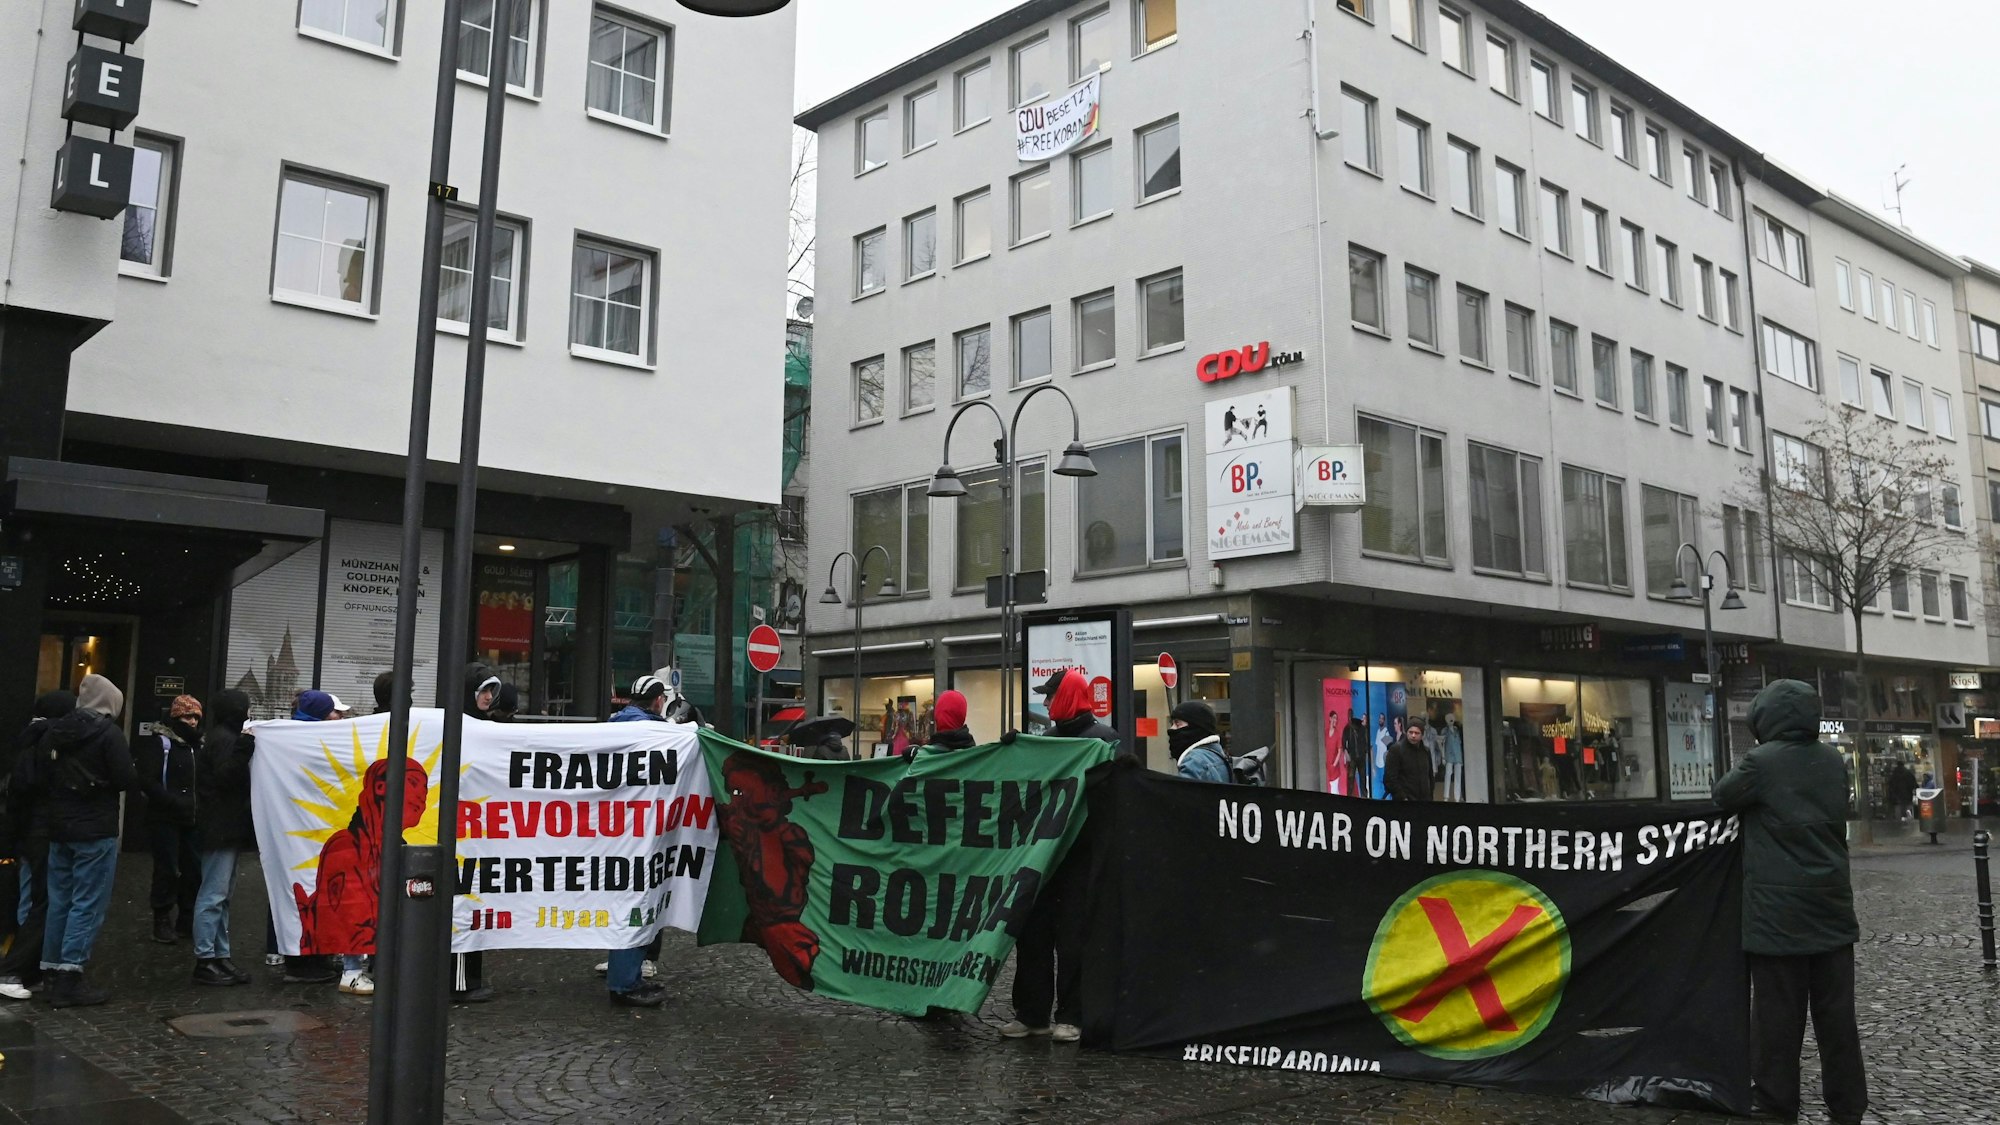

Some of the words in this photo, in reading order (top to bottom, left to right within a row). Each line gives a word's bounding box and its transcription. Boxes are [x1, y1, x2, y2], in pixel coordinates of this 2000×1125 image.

[1018, 106, 1045, 133] CDU
[1046, 81, 1093, 125] BESETZT
[436, 184, 452, 198] 17
[1196, 341, 1271, 383] CDU
[1272, 350, 1304, 368] KÖLN
[1211, 530, 1290, 549] NIGGEMANN
[346, 571, 424, 586] GOLDHANL
[422, 566, 430, 575] &
[484, 565, 506, 576] GOLD
[1951, 675, 1978, 686] Kiosk
[1835, 721, 1845, 734] 54
[509, 749, 678, 790] FRAUEN
[457, 794, 714, 839] REVOLUTION
[838, 774, 1079, 849] DEFEND
[1218, 798, 1262, 844] NO
[1275, 808, 1353, 853] WAR
[1365, 815, 1411, 861] ON
[1426, 824, 1624, 872] NORTHERN
[1636, 812, 1741, 866] SYRIA
[454, 844, 706, 895] VERTEIDIGEN
[470, 908, 513, 931] Jin
[535, 906, 609, 930] Jiyan
[841, 946, 953, 988] WIDERSTAND
